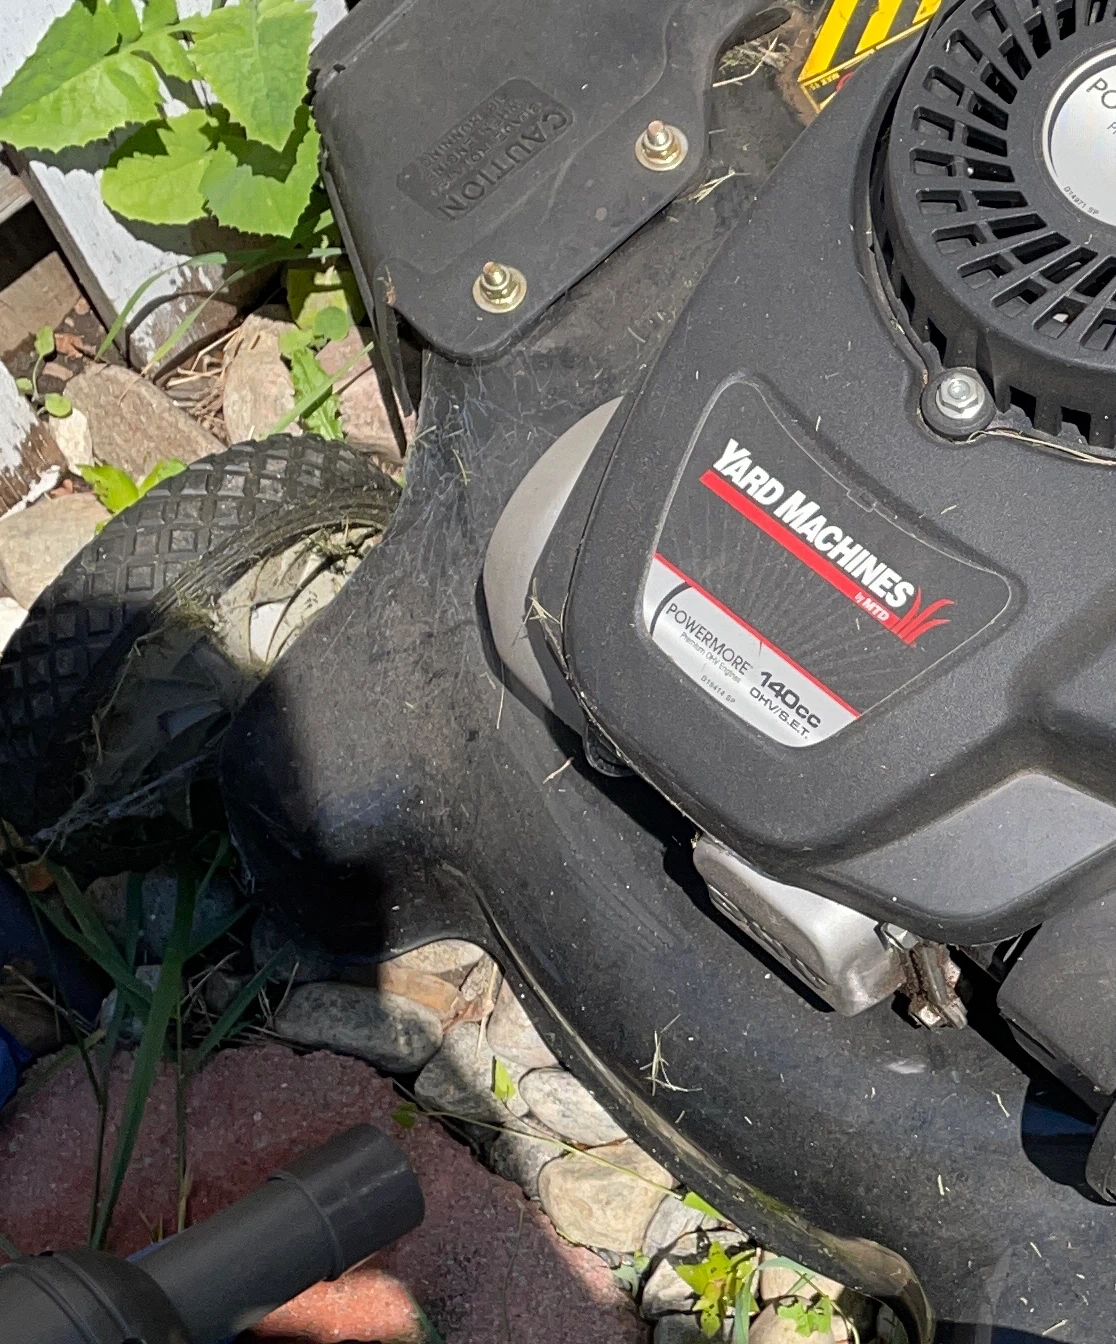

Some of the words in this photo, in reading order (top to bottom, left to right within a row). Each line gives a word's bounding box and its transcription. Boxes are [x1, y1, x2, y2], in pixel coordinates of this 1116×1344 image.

[437, 111, 569, 220] CAUTION
[713, 437, 785, 505] YARD
[773, 489, 916, 608] MACHINES
[666, 602, 750, 676] POWERMORE
[862, 598, 890, 622] MTD
[679, 631, 706, 656] Premium
[705, 649, 721, 666] OHV
[718, 661, 742, 684] Engines
[749, 686, 811, 740] OHV/S.E.T.
[760, 670, 821, 729] 140cc
